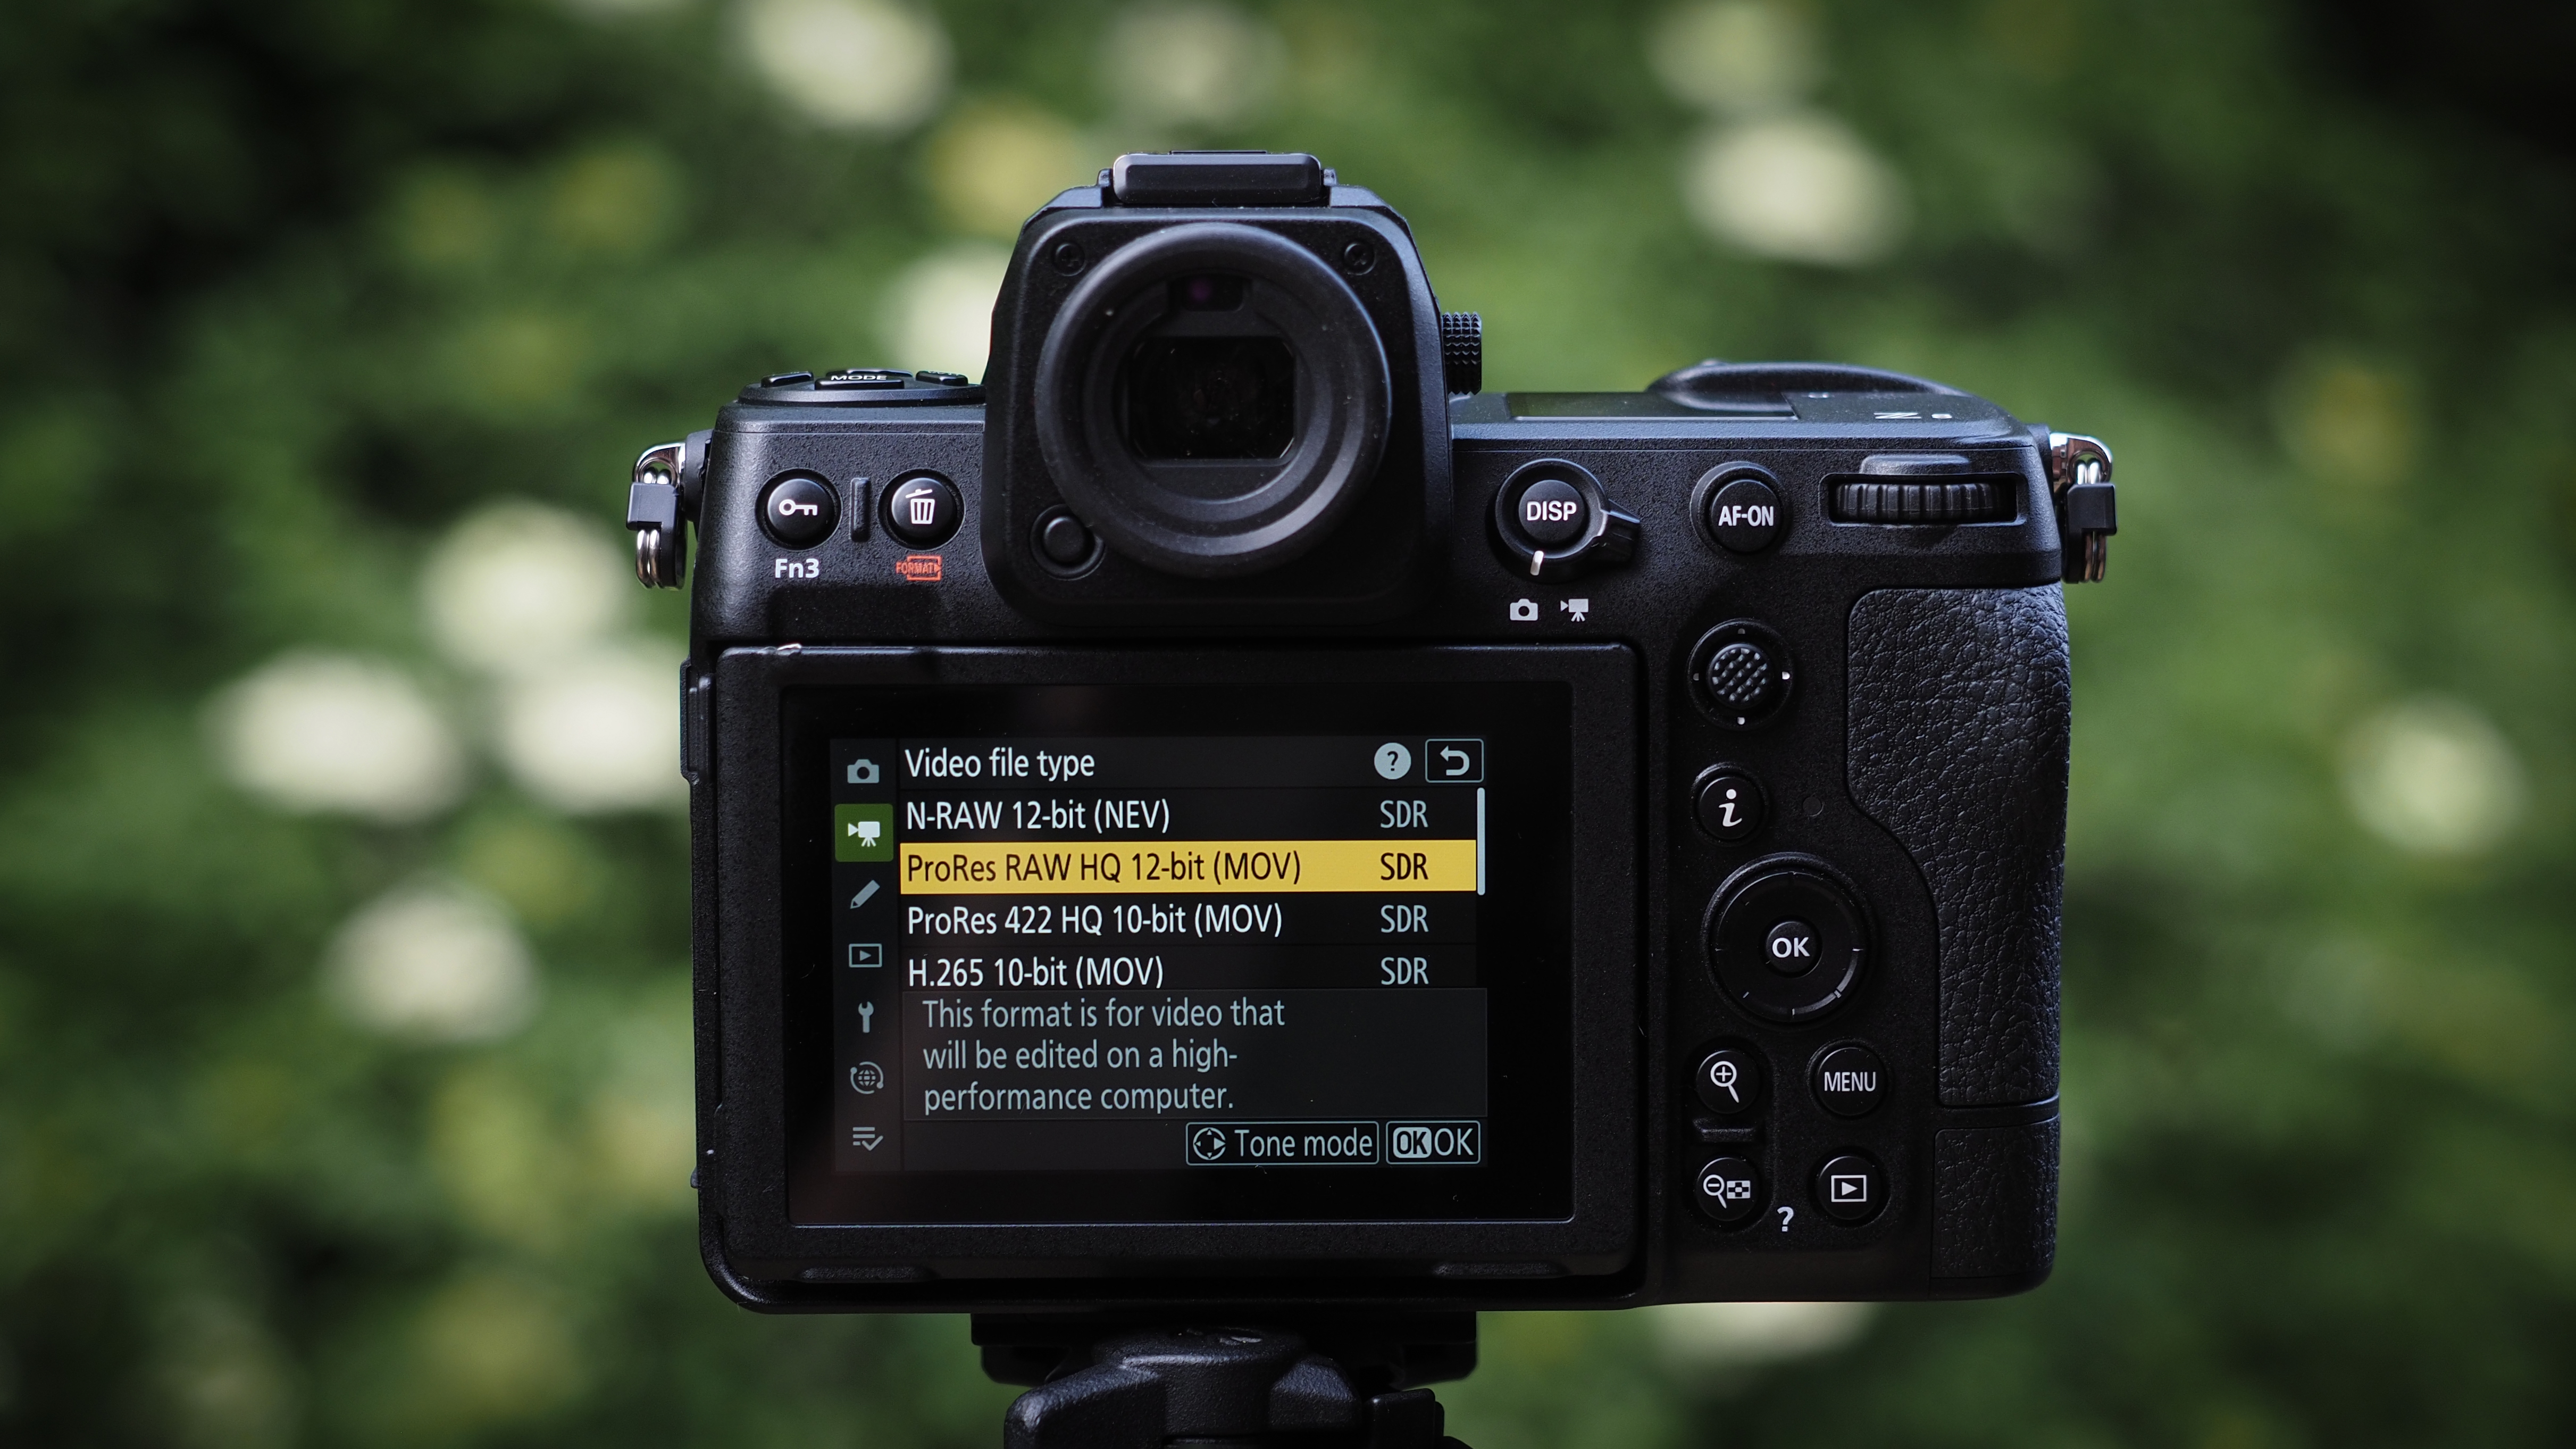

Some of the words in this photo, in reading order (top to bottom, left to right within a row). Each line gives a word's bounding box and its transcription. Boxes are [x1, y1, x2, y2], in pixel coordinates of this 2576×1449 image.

[1527, 500, 1577, 521] DISP
[1718, 505, 1774, 527] AF-ON
[775, 557, 819, 578] Fn3
[896, 561, 935, 574] FORMAT
[905, 747, 981, 777] Video
[989, 747, 1029, 777] file
[1036, 750, 1095, 782] type
[907, 801, 1003, 830] N-RAW
[1013, 799, 1086, 829] 12-bit
[1094, 798, 1169, 834] (NEV)
[1380, 800, 1428, 828] SDR
[1718, 789, 1742, 827] i
[908, 854, 996, 882] ProRes
[1006, 853, 1072, 881] RAW
[1081, 853, 1120, 883] HQ
[1132, 851, 1205, 880] 12-bit
[1214, 850, 1300, 885] (MOV)
[1381, 852, 1428, 881] SDR
[908, 906, 997, 935] ProRes
[1005, 905, 1052, 934] 422
[1062, 905, 1102, 936] HQ
[1113, 903, 1186, 933] 10-bit
[1194, 903, 1282, 938] (MOV)
[1381, 904, 1429, 933] SDR
[1772, 937, 1810, 958] OK
[909, 958, 983, 987] H.265
[994, 956, 1068, 986] 10-bit
[1076, 955, 1163, 989] (MOV)
[1381, 957, 1429, 985] SDR
[922, 998, 973, 1028] This
[981, 998, 1072, 1028] format
[1081, 997, 1097, 1027] is
[1105, 997, 1144, 1027] for
[1151, 997, 1222, 1027] video
[1230, 996, 1285, 1026] that
[923, 1039, 966, 1069] will
[976, 1039, 1007, 1069] be
[1016, 1039, 1097, 1069] edited
[1107, 1047, 1140, 1068] on
[1149, 1047, 1162, 1068] a
[1173, 1038, 1237, 1073] high-
[1824, 1071, 1876, 1092] MENU
[925, 1081, 1092, 1116] performance
[1101, 1083, 1233, 1114] computer.
[1234, 1129, 1295, 1157] Tone
[1304, 1127, 1373, 1156] mode
[1396, 1130, 1428, 1155] OK
[1434, 1128, 1474, 1156] OK
